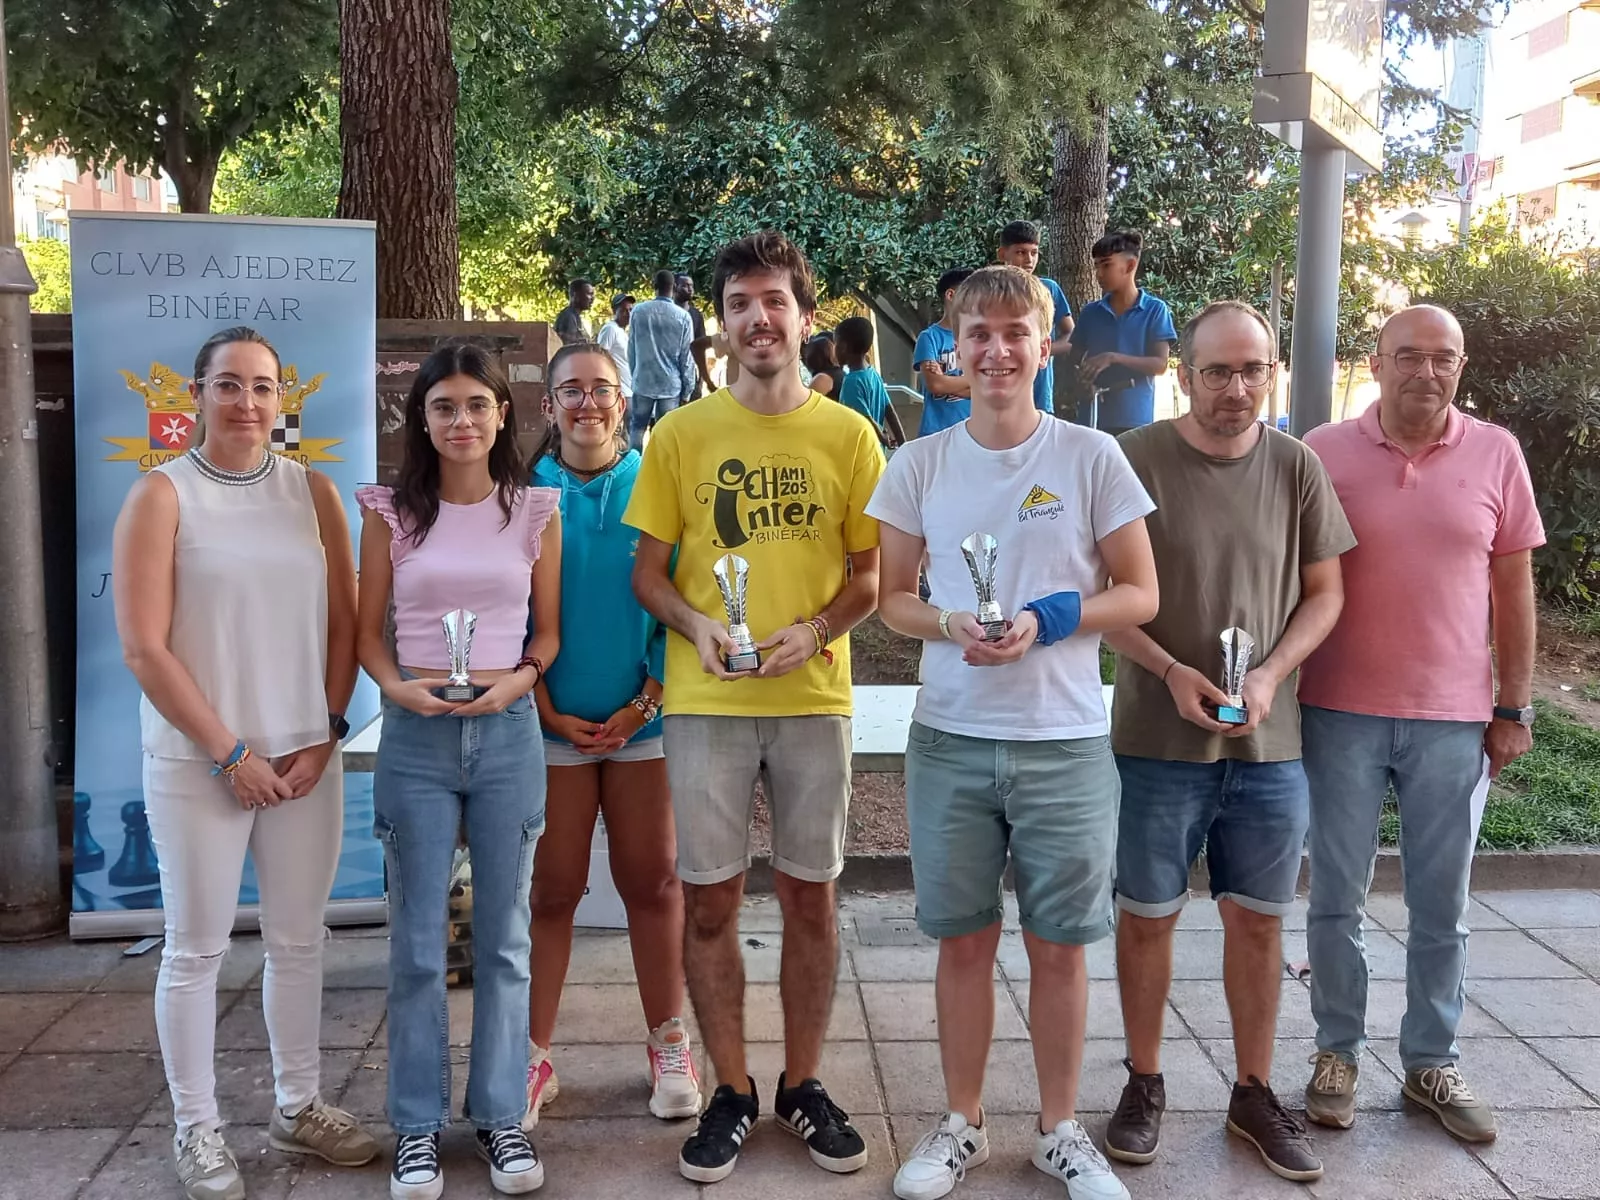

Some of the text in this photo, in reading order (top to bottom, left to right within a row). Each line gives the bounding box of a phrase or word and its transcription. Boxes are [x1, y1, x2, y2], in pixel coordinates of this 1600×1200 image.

[90, 251, 358, 284] CLVB AJEDREZ
[146, 291, 303, 322] BINÉFAR
[779, 481, 808, 497] ZOS
[755, 526, 823, 545] BINÉFAR
